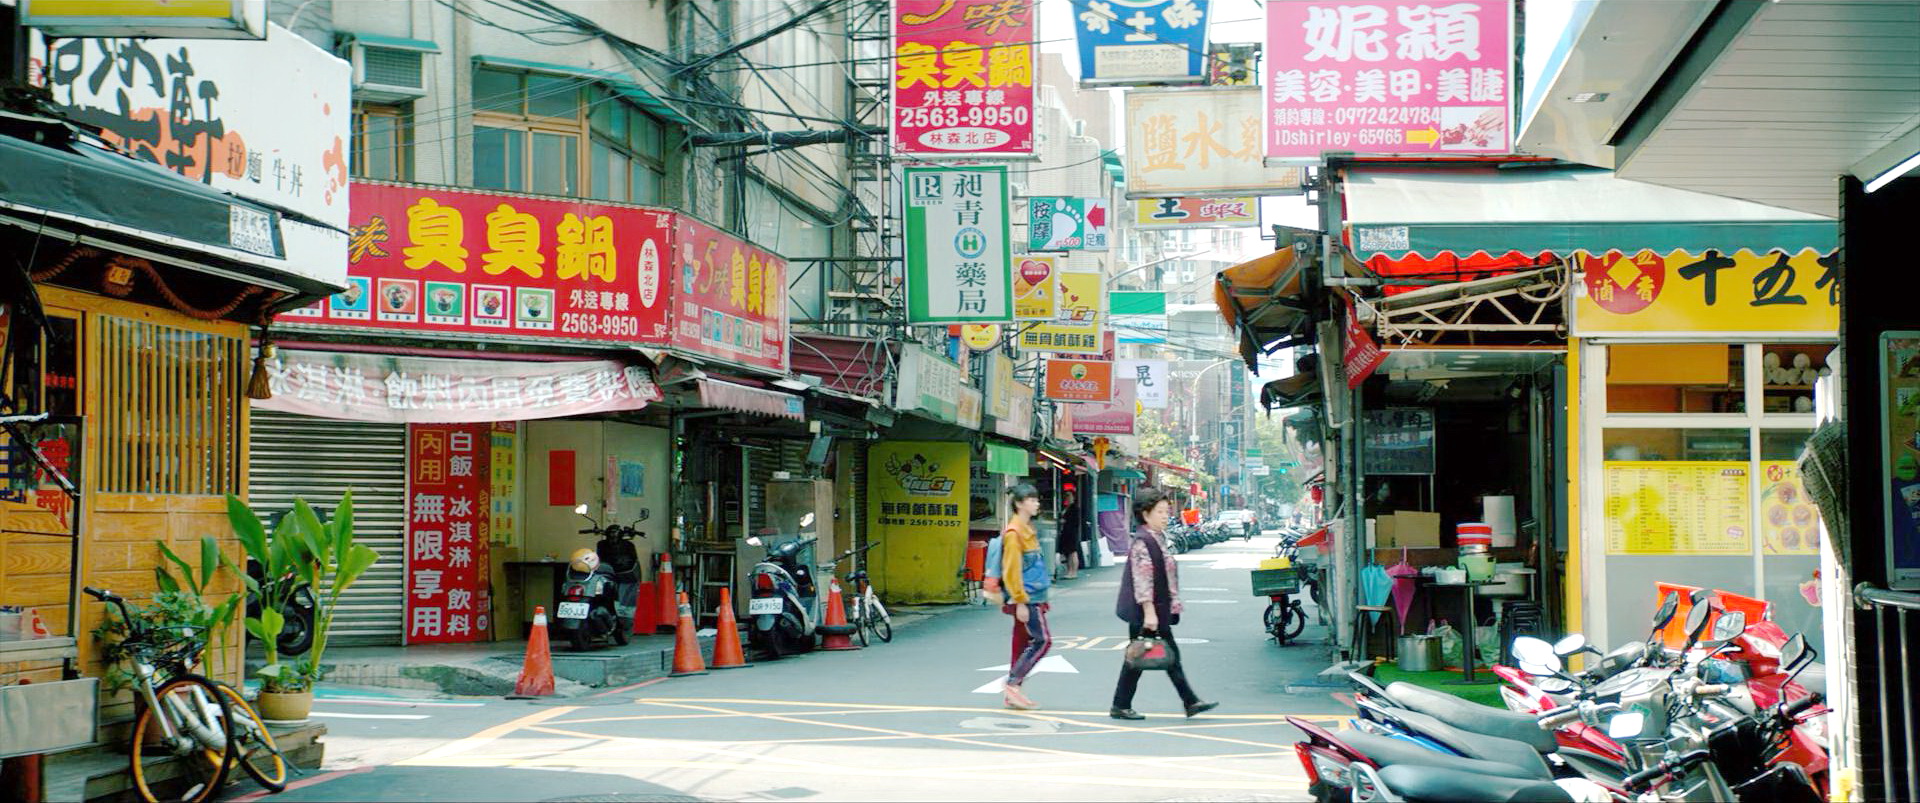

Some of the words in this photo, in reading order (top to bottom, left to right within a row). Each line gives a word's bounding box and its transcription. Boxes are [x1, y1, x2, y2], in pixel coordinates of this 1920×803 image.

[896, 41, 1032, 89] 臭臭鍋
[901, 106, 1028, 127] 2563-9950
[561, 312, 638, 336] 2563-9950
[1136, 365, 1154, 387] 晃
[411, 493, 445, 637] 無限享用
